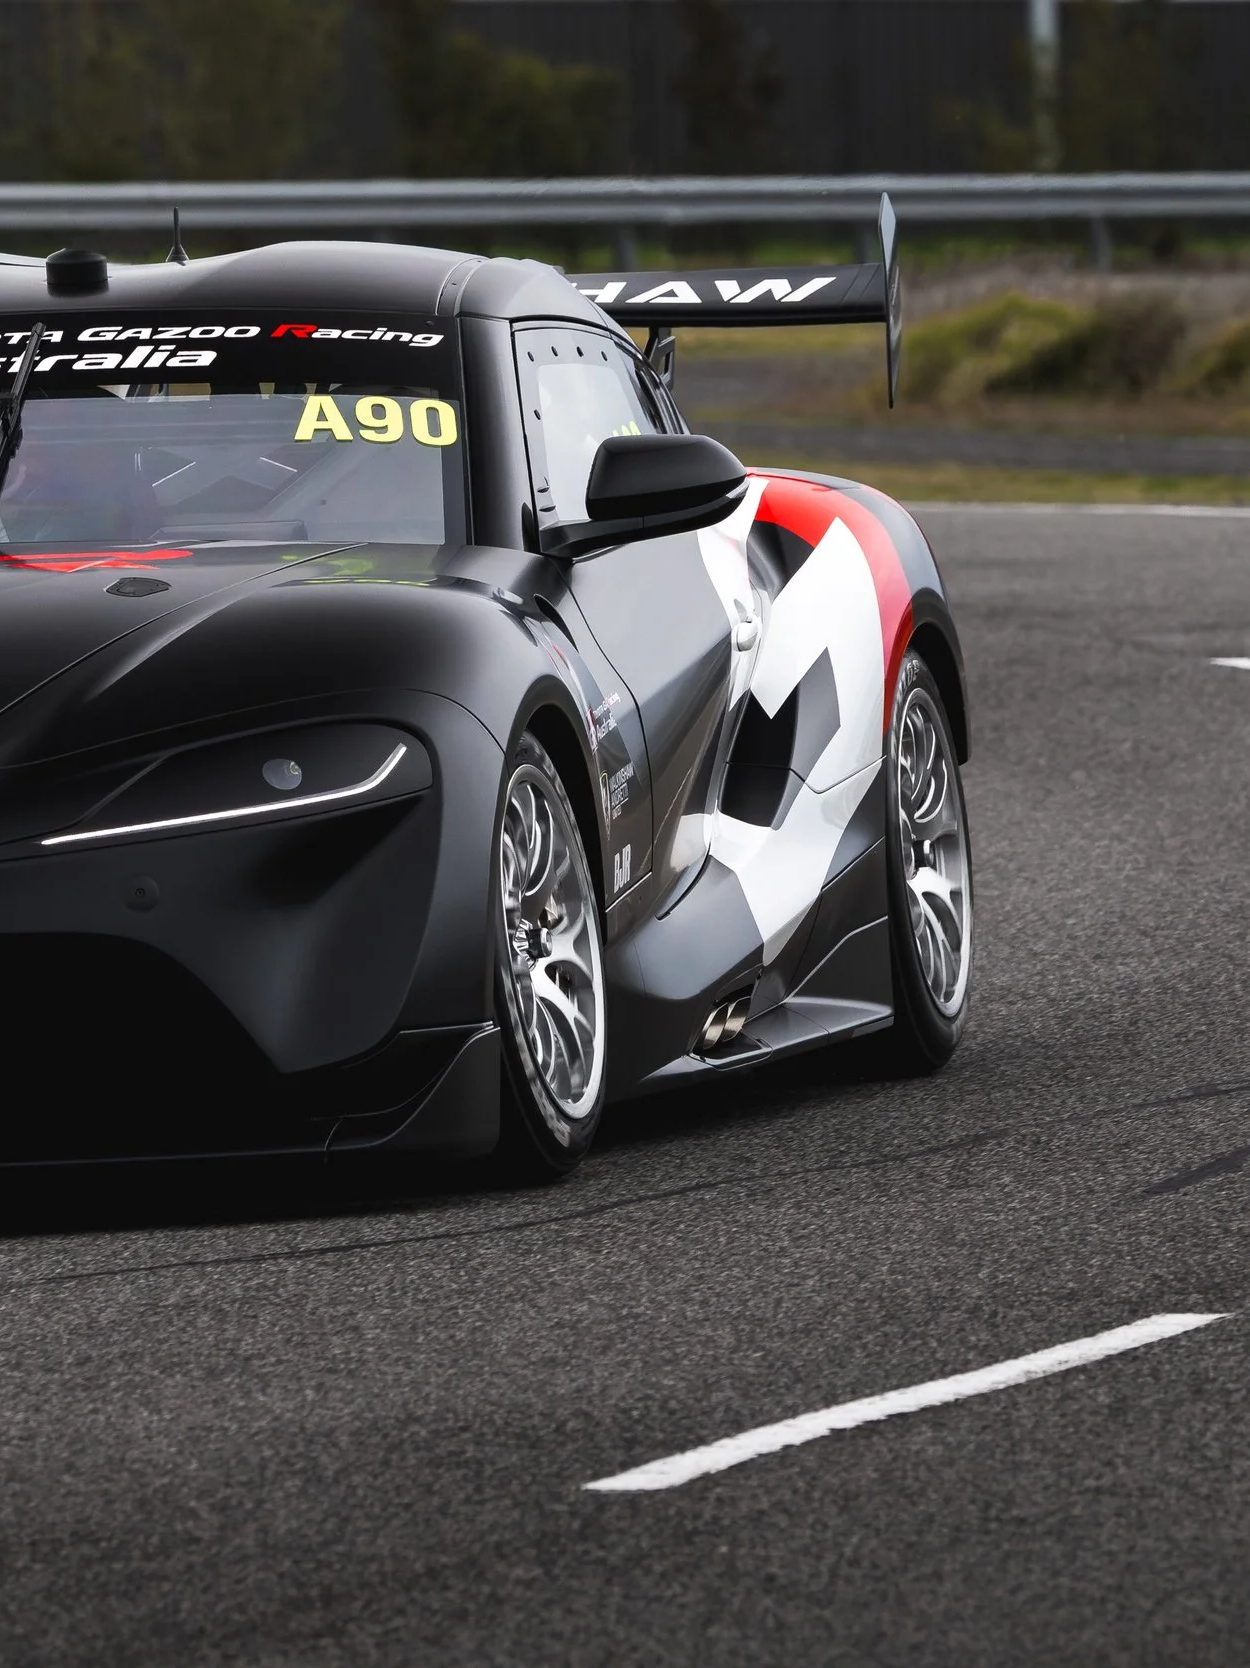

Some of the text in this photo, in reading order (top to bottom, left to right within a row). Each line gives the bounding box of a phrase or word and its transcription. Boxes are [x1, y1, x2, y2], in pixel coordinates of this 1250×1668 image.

[77, 326, 261, 342] GAZOO
[270, 324, 445, 347] Racing
[294, 395, 458, 447] A90
[614, 843, 631, 894] BJR
